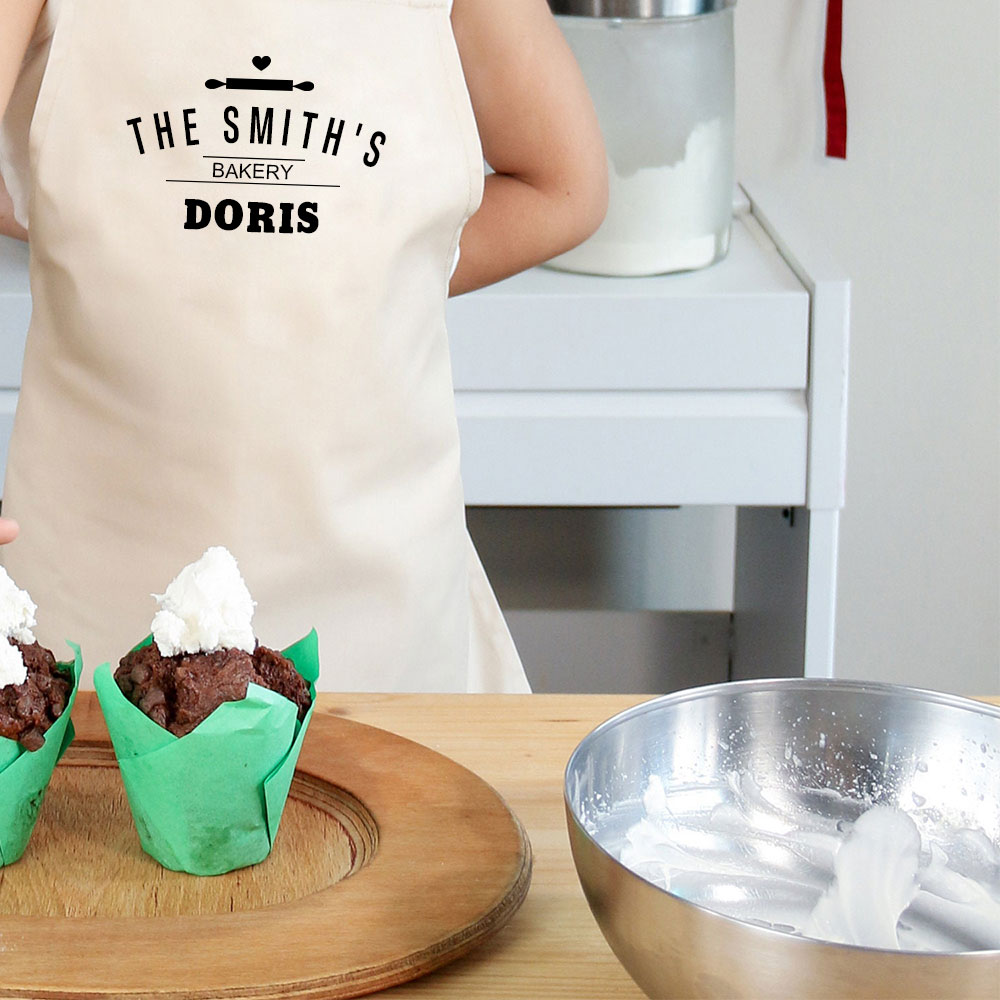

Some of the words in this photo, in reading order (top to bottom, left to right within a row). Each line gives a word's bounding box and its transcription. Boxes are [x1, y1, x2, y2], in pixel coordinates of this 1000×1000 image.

[126, 107, 200, 155] THE
[223, 105, 387, 168] SMITH'S
[211, 162, 294, 180] BAKERY
[183, 198, 319, 234] DORIS
